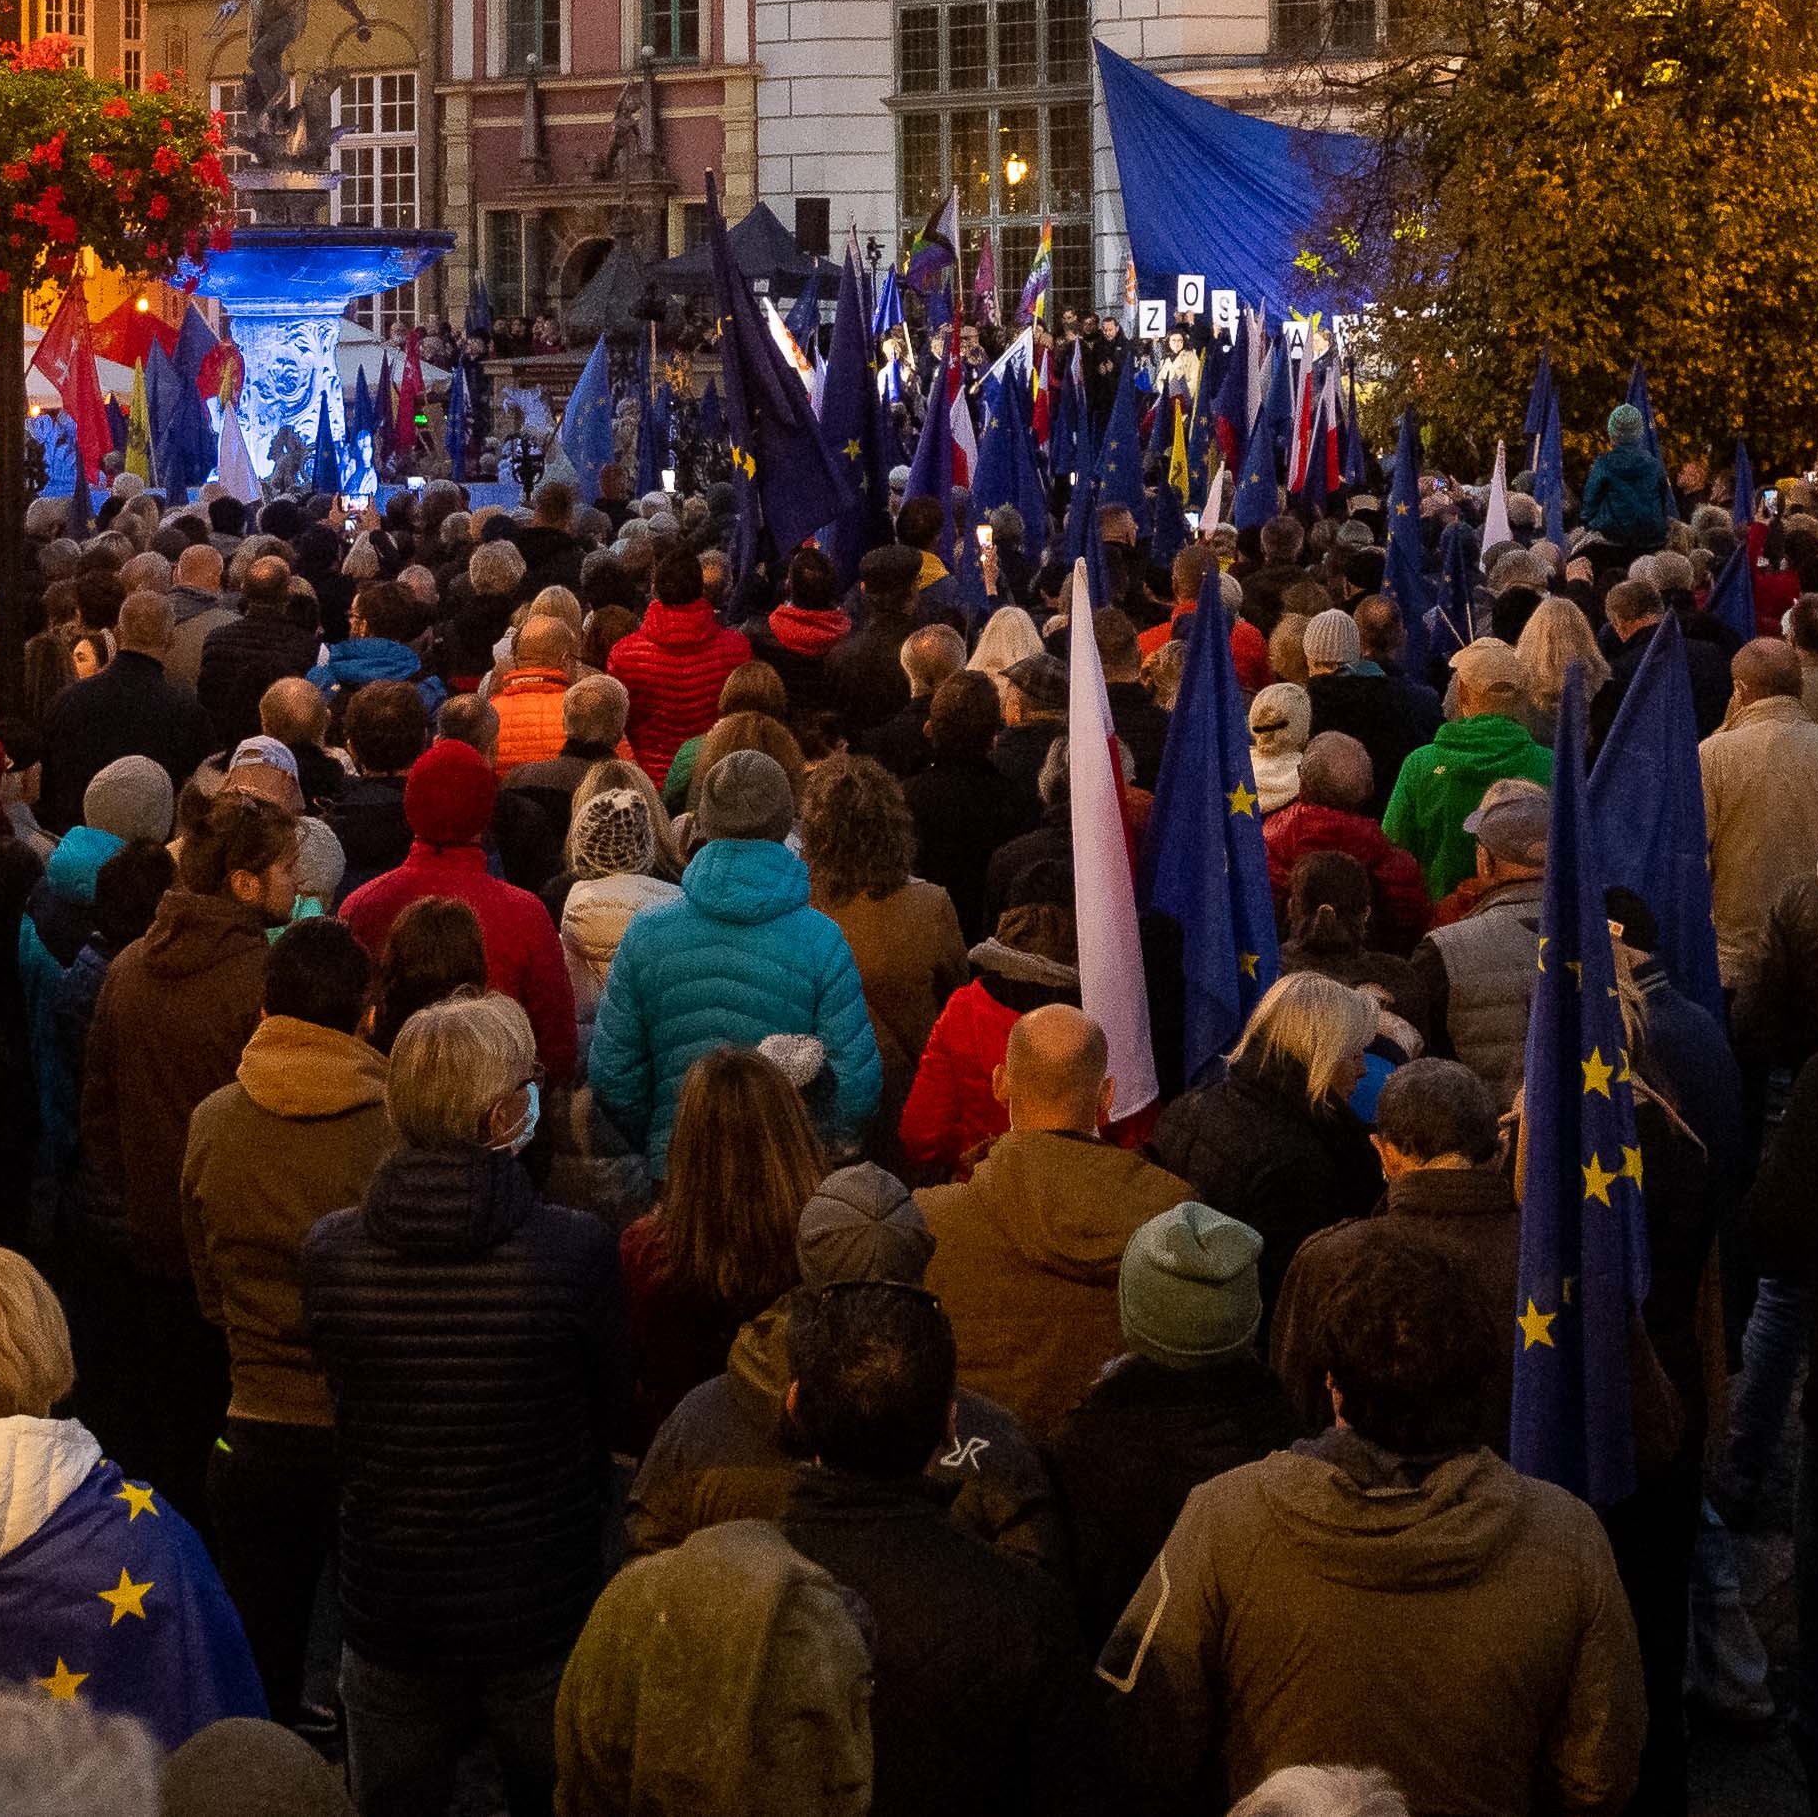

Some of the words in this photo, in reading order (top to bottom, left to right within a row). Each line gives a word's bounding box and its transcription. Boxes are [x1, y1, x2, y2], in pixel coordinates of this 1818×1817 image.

[1183, 282, 1199, 306] O
[1146, 307, 1160, 331] Z
[1218, 296, 1231, 322] S
[1290, 328, 1305, 352] A
